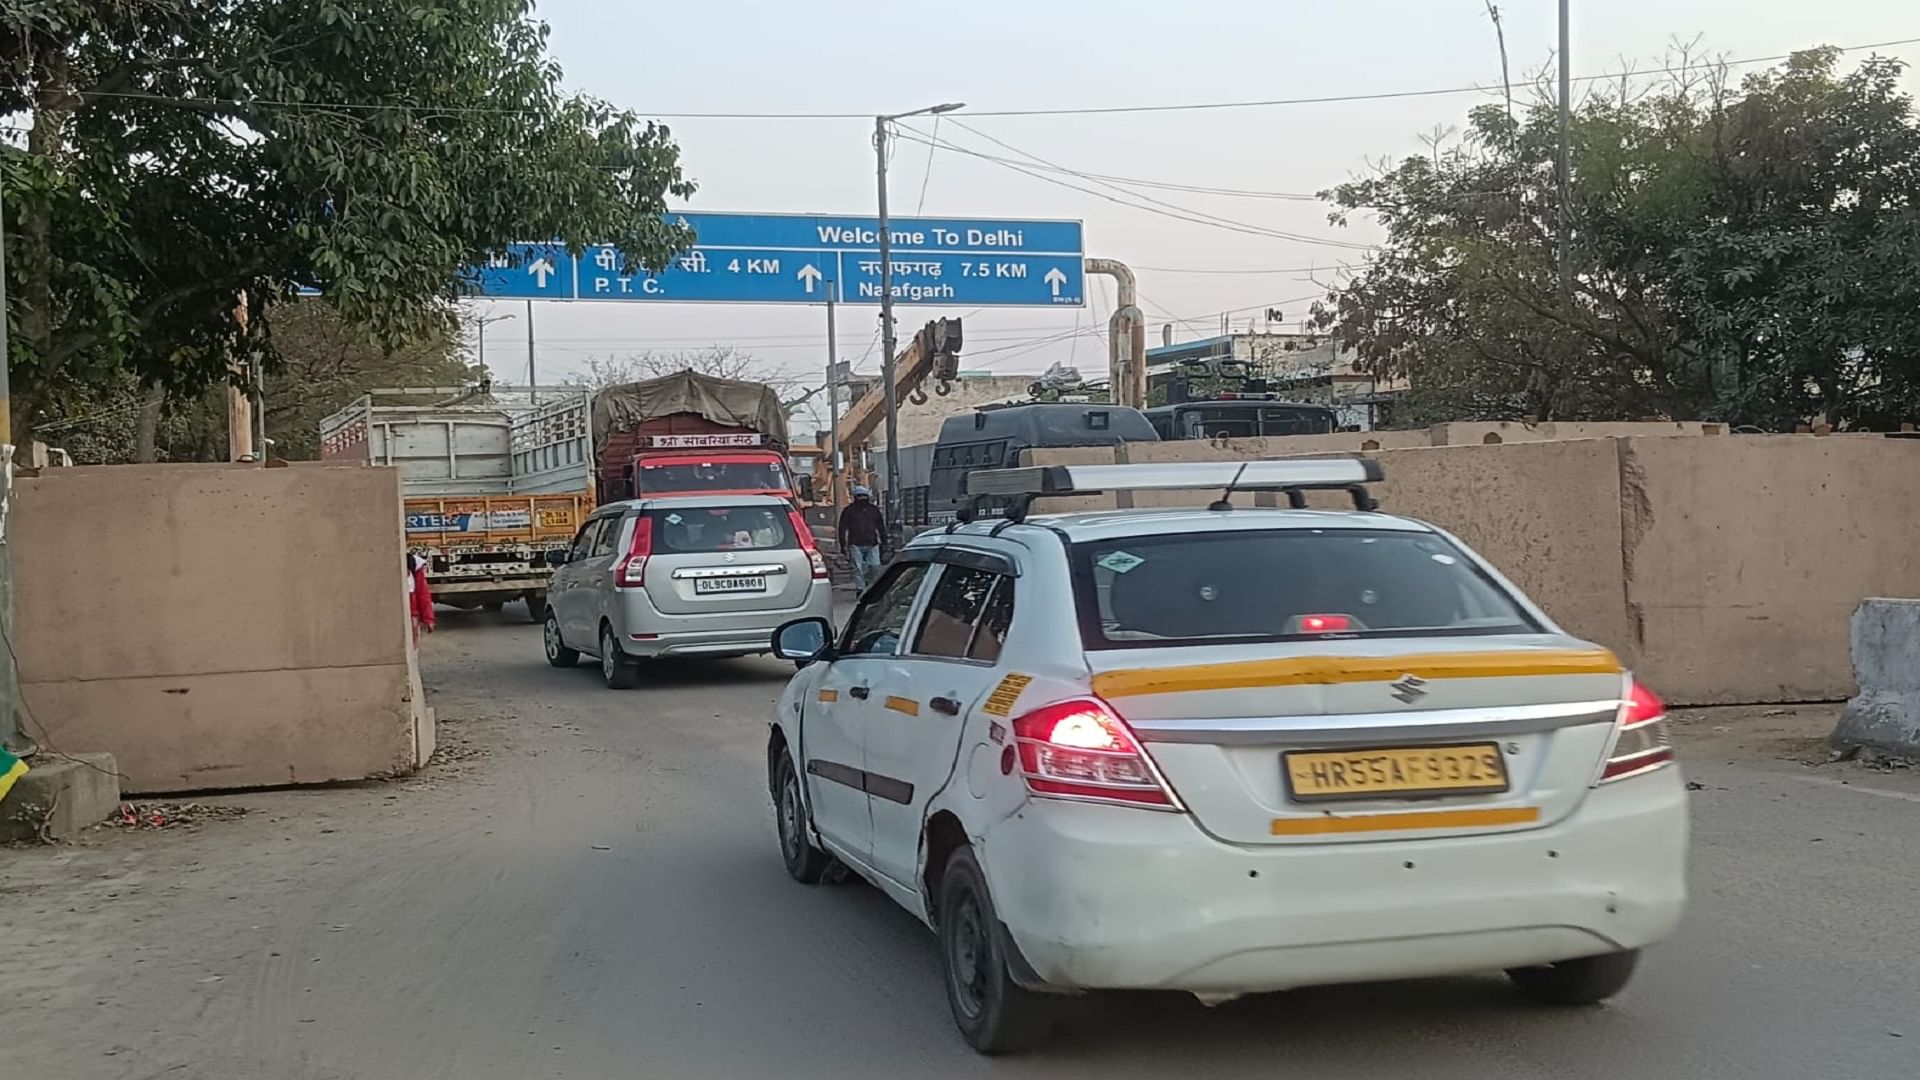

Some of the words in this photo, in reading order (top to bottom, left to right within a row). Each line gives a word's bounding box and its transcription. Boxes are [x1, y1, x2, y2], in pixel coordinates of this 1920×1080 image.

[932, 229, 960, 246] To
[967, 229, 1024, 247] Delhi
[728, 258, 741, 273] 4
[747, 259, 780, 274] KM
[961, 263, 990, 278] 7.5
[996, 263, 1027, 278] KM
[595, 277, 610, 293] P.
[616, 277, 633, 293] T.
[643, 278, 666, 294] C.
[859, 282, 954, 300] Naafgarh
